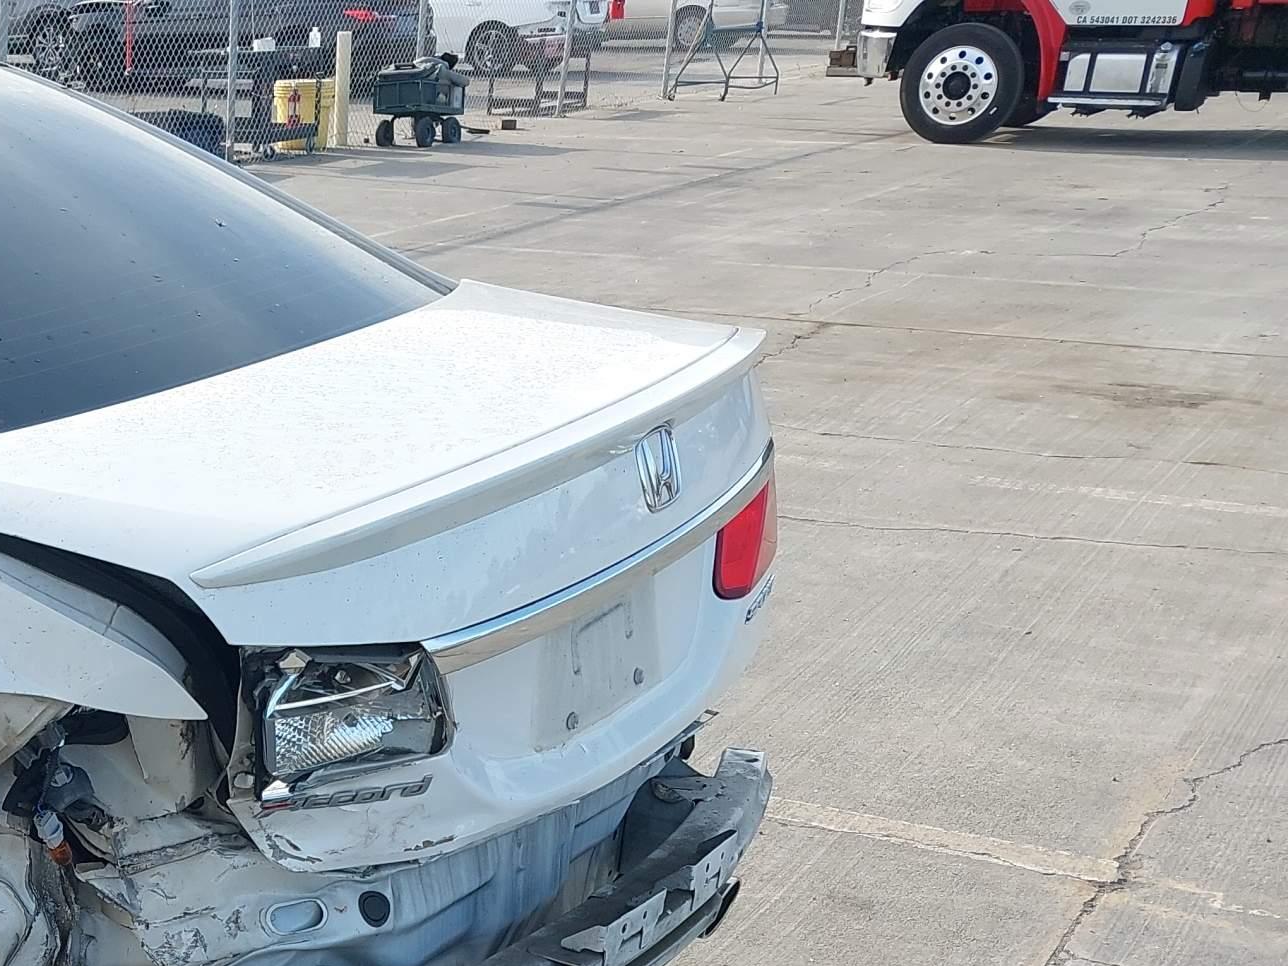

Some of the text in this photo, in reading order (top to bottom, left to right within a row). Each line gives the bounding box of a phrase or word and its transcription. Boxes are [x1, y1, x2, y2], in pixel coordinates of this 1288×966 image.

[1076, 16, 1178, 24] CA 543041 DOT 3242336
